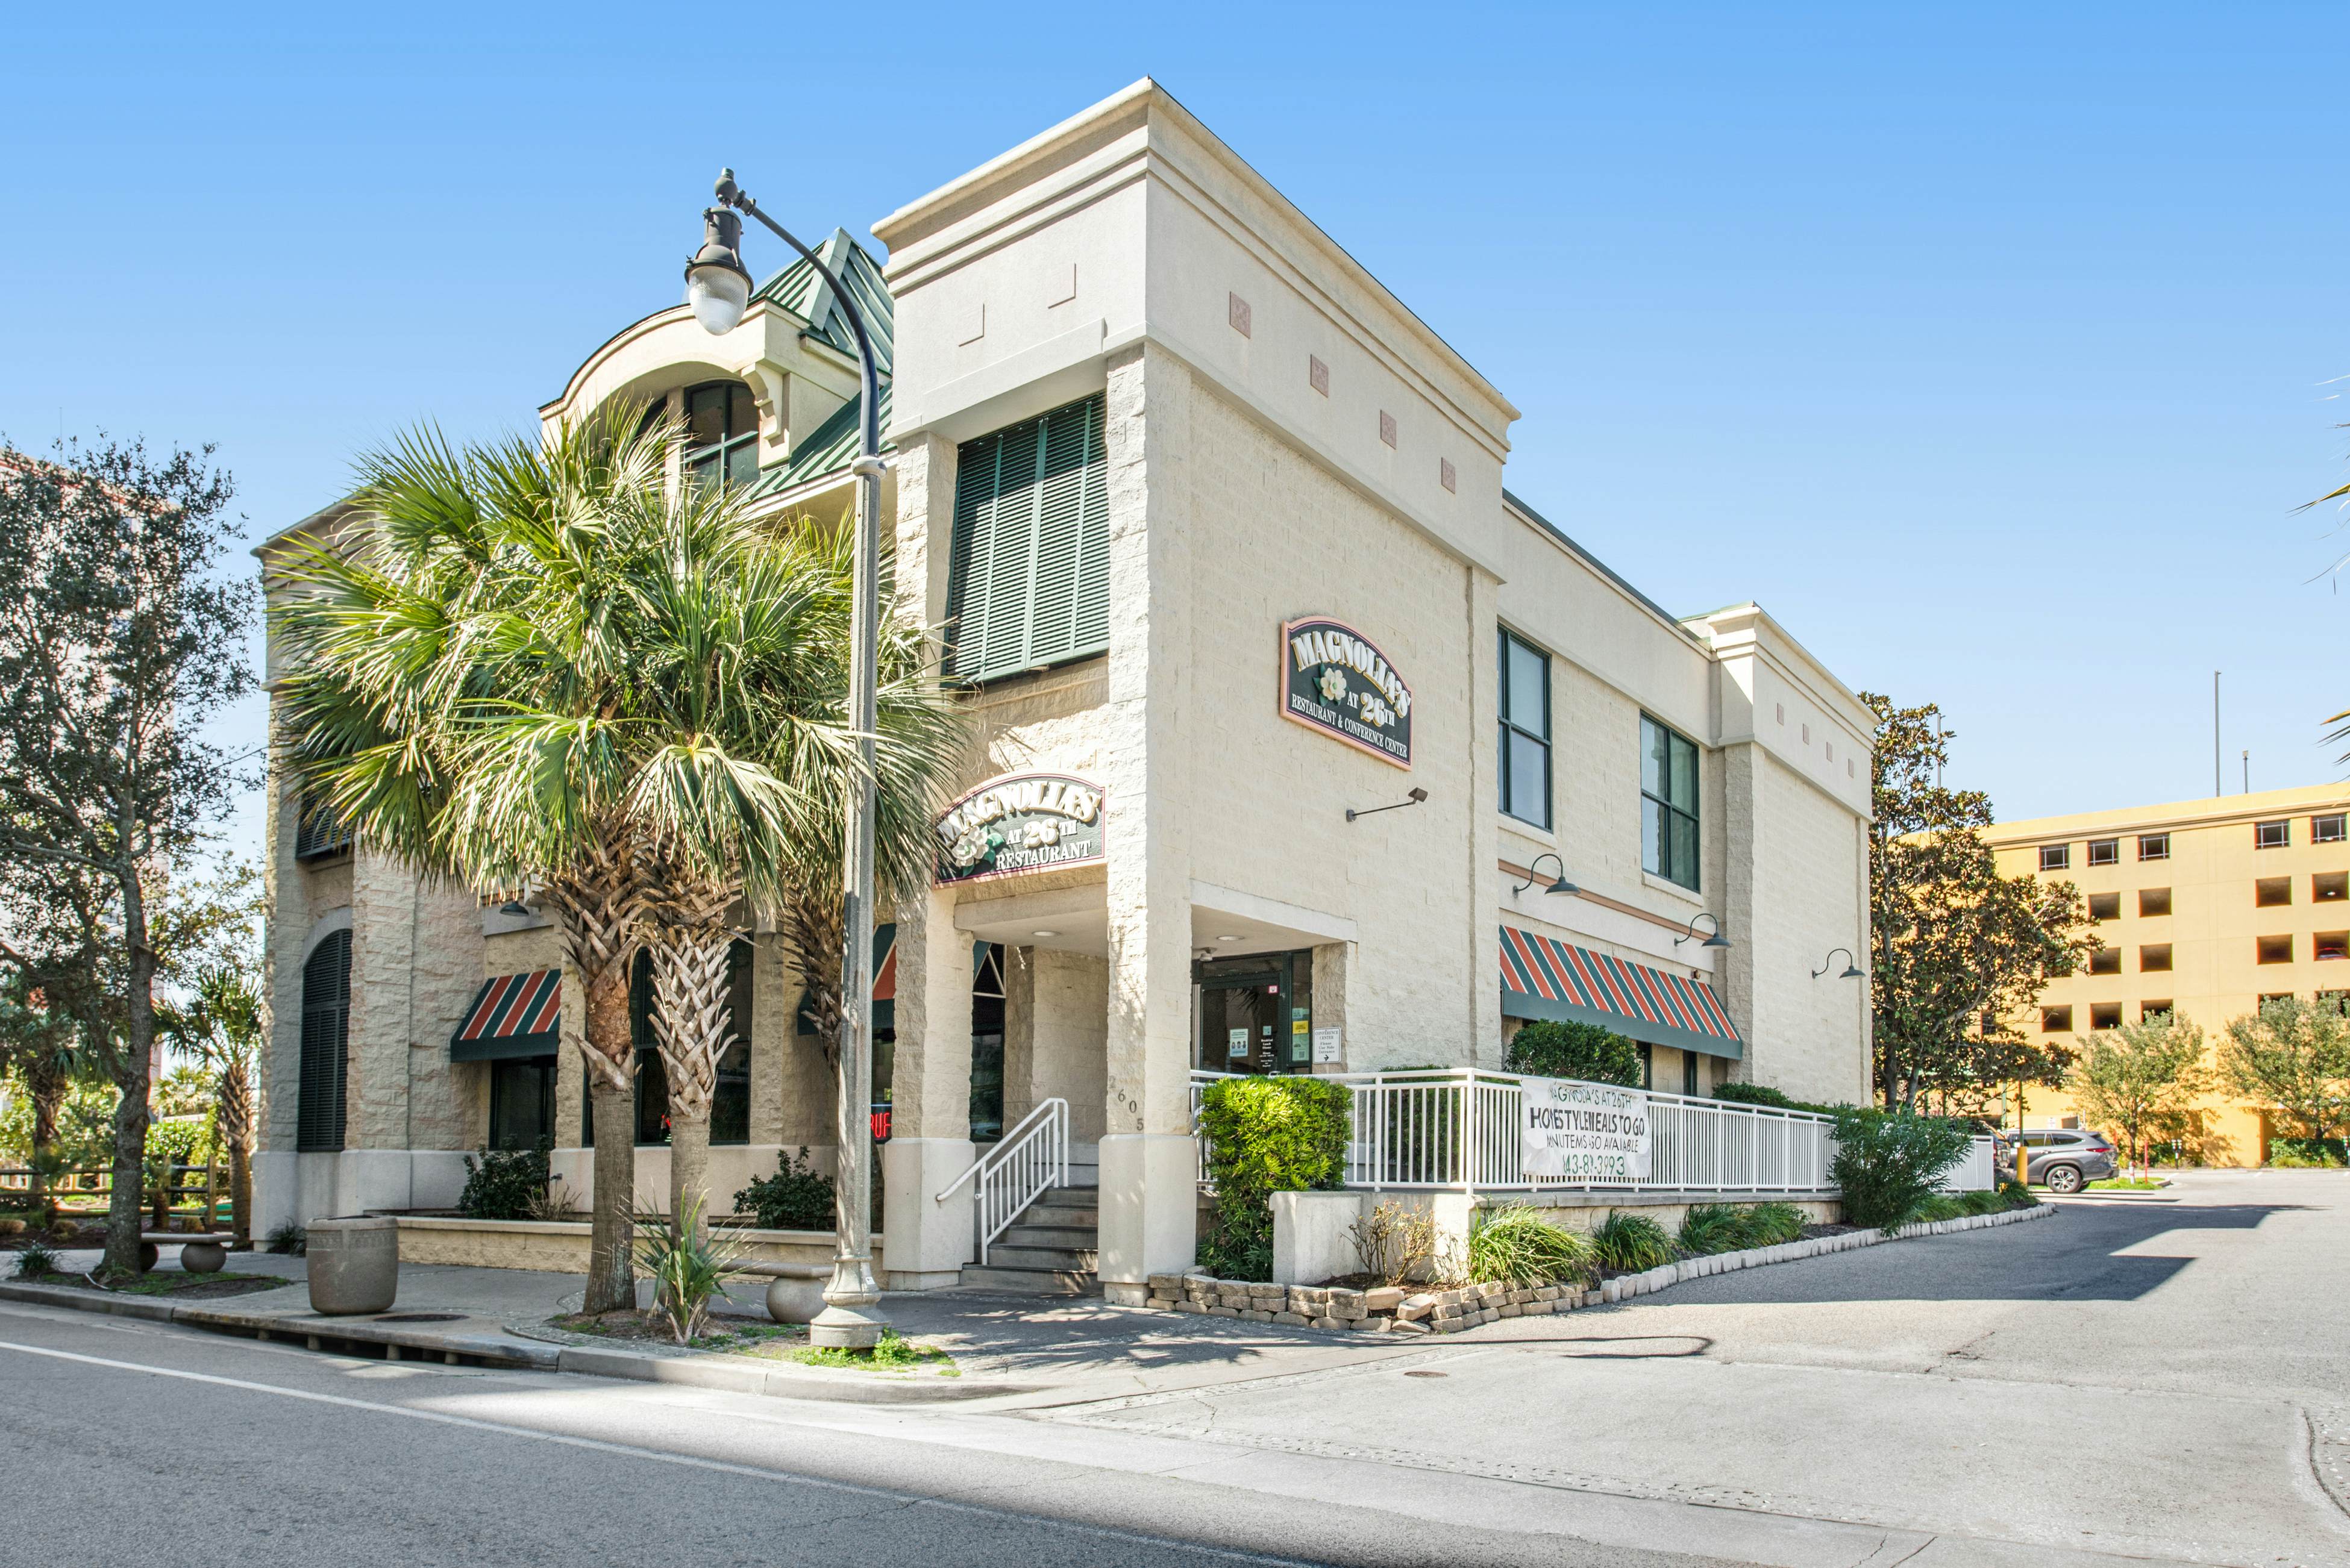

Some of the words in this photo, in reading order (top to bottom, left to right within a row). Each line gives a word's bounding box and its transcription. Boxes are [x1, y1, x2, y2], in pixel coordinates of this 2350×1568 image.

[1291, 631, 1411, 719] MAGNOLIA'S
[1347, 692, 1358, 710] AT
[1360, 692, 1395, 727] 26TH
[1291, 693, 1336, 725] RESTAURANT
[1338, 715, 1343, 728] &
[1344, 717, 1383, 747] CONFERENCE
[1385, 737, 1408, 758] CENTER
[1006, 829, 1023, 845] AT
[1023, 817, 1077, 848] 26TH
[996, 840, 1091, 870] RESTAURANT
[1602, 1091, 1610, 1106] AT
[1612, 1092, 1632, 1109] 26TH
[1619, 1115, 1631, 1135] TO
[1633, 1117, 1644, 1136] GO
